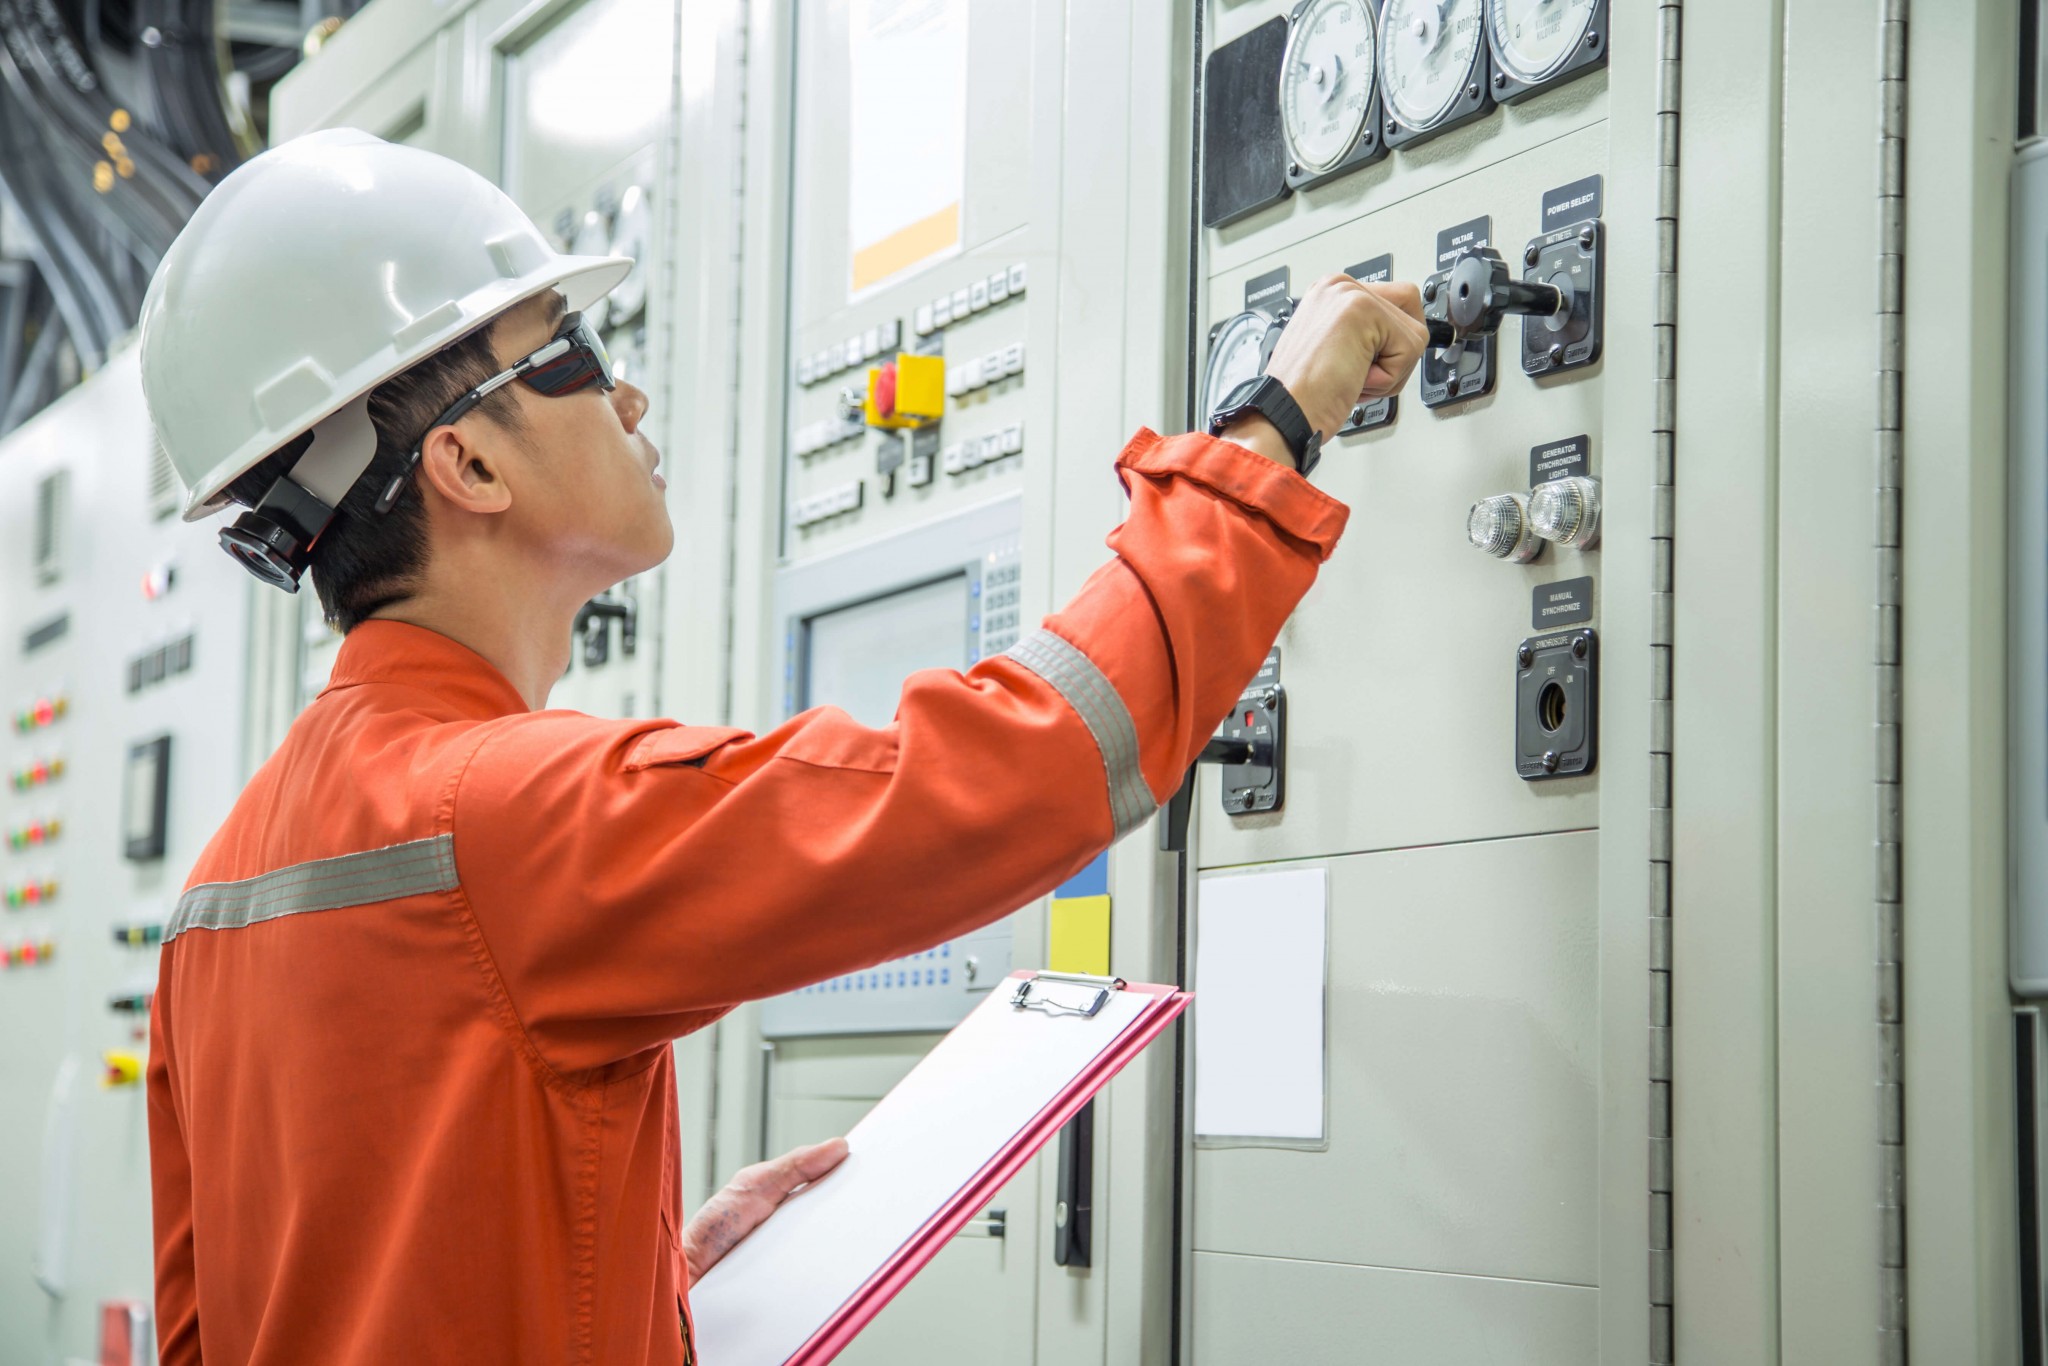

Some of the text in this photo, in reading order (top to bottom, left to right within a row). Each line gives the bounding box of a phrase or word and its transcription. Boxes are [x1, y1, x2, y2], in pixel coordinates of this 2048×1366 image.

[1547, 192, 1595, 216] POWER SELECT
[1451, 231, 1474, 246] VOLTAGE
[1369, 268, 1388, 282] SELECT
[1542, 443, 1577, 459] GENERATOR
[1537, 453, 1581, 471] SYNCHRONIZING
[1548, 468, 1569, 480] LIGHTS
[1549, 591, 1573, 602] MANUAL
[1541, 602, 1581, 616] SYNCHRONIZE
[1535, 635, 1568, 649] SYNCHROSCOPE
[1547, 666, 1556, 675] OFF
